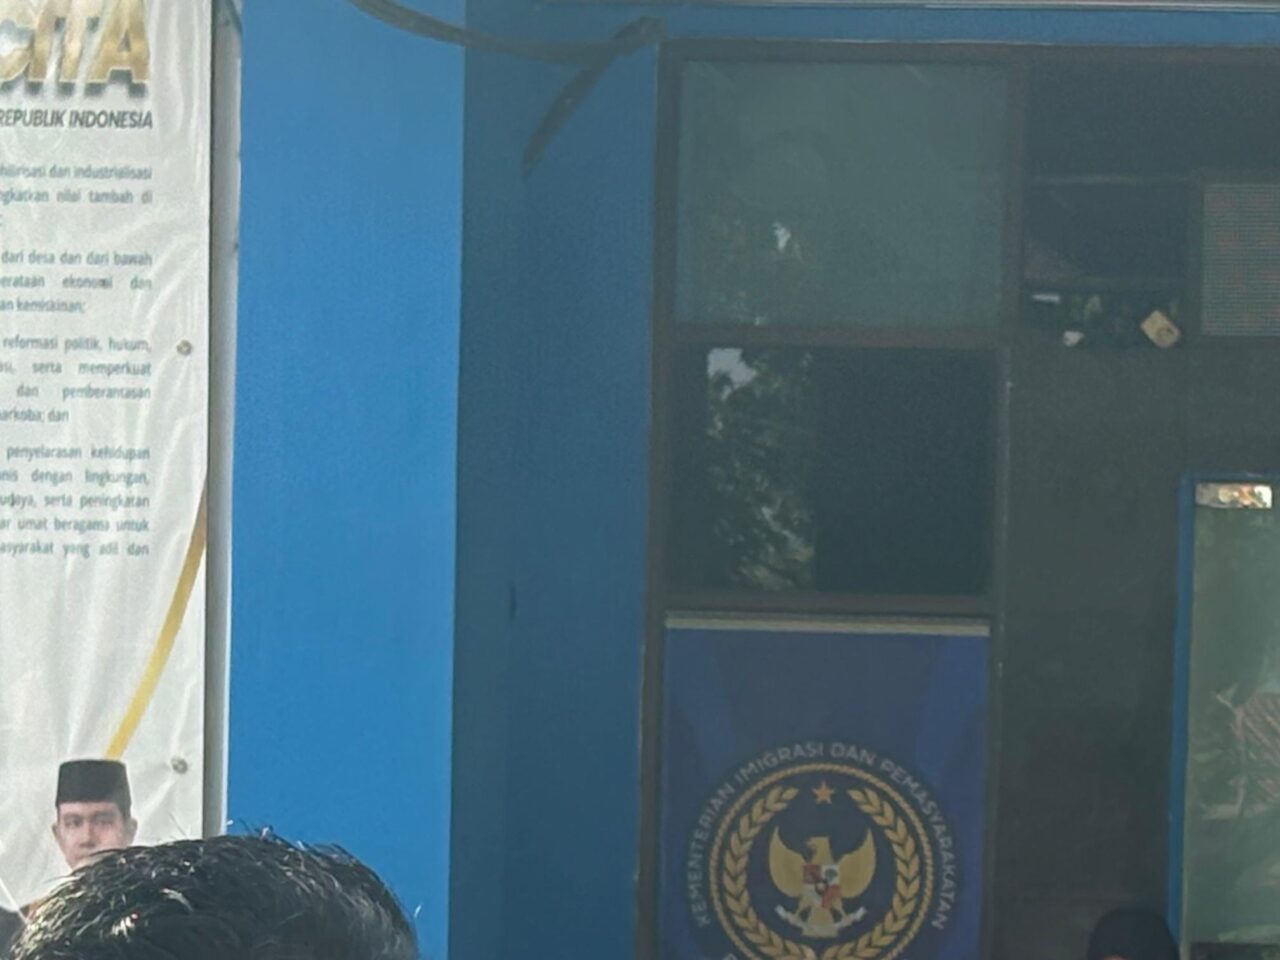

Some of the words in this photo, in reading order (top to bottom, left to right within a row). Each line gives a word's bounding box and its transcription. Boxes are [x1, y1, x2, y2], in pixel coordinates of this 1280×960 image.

[69, 110, 153, 129] INDONESIA
[49, 164, 70, 178] dan
[89, 190, 133, 203] tambah
[1, 250, 24, 264] dari
[28, 249, 55, 264] desa
[60, 250, 81, 265] dan
[87, 251, 109, 265] dari
[113, 251, 152, 265] bawah
[62, 274, 112, 288] ekonomi
[130, 275, 152, 289] dan
[3, 335, 58, 349] reformasi
[32, 361, 62, 374] serta
[78, 361, 151, 377] memperkuat
[17, 383, 38, 397] dan
[62, 383, 151, 402] pemberantasan
[47, 409, 69, 422] dan
[7, 444, 82, 462] penyelarasan
[31, 469, 73, 486] dengan
[44, 495, 72, 506] serta
[80, 494, 150, 511] peningkatan
[18, 519, 48, 531] umat
[54, 518, 110, 534] beragama
[116, 519, 149, 531] untuk
[63, 543, 90, 558] yang
[127, 542, 150, 555] dan
[687, 782, 735, 927] KEMENTERIAN
[734, 742, 824, 785] IMIGRASI
[830, 742, 876, 766] DAN
[880, 757, 955, 930] PEMASYARAKATAN
